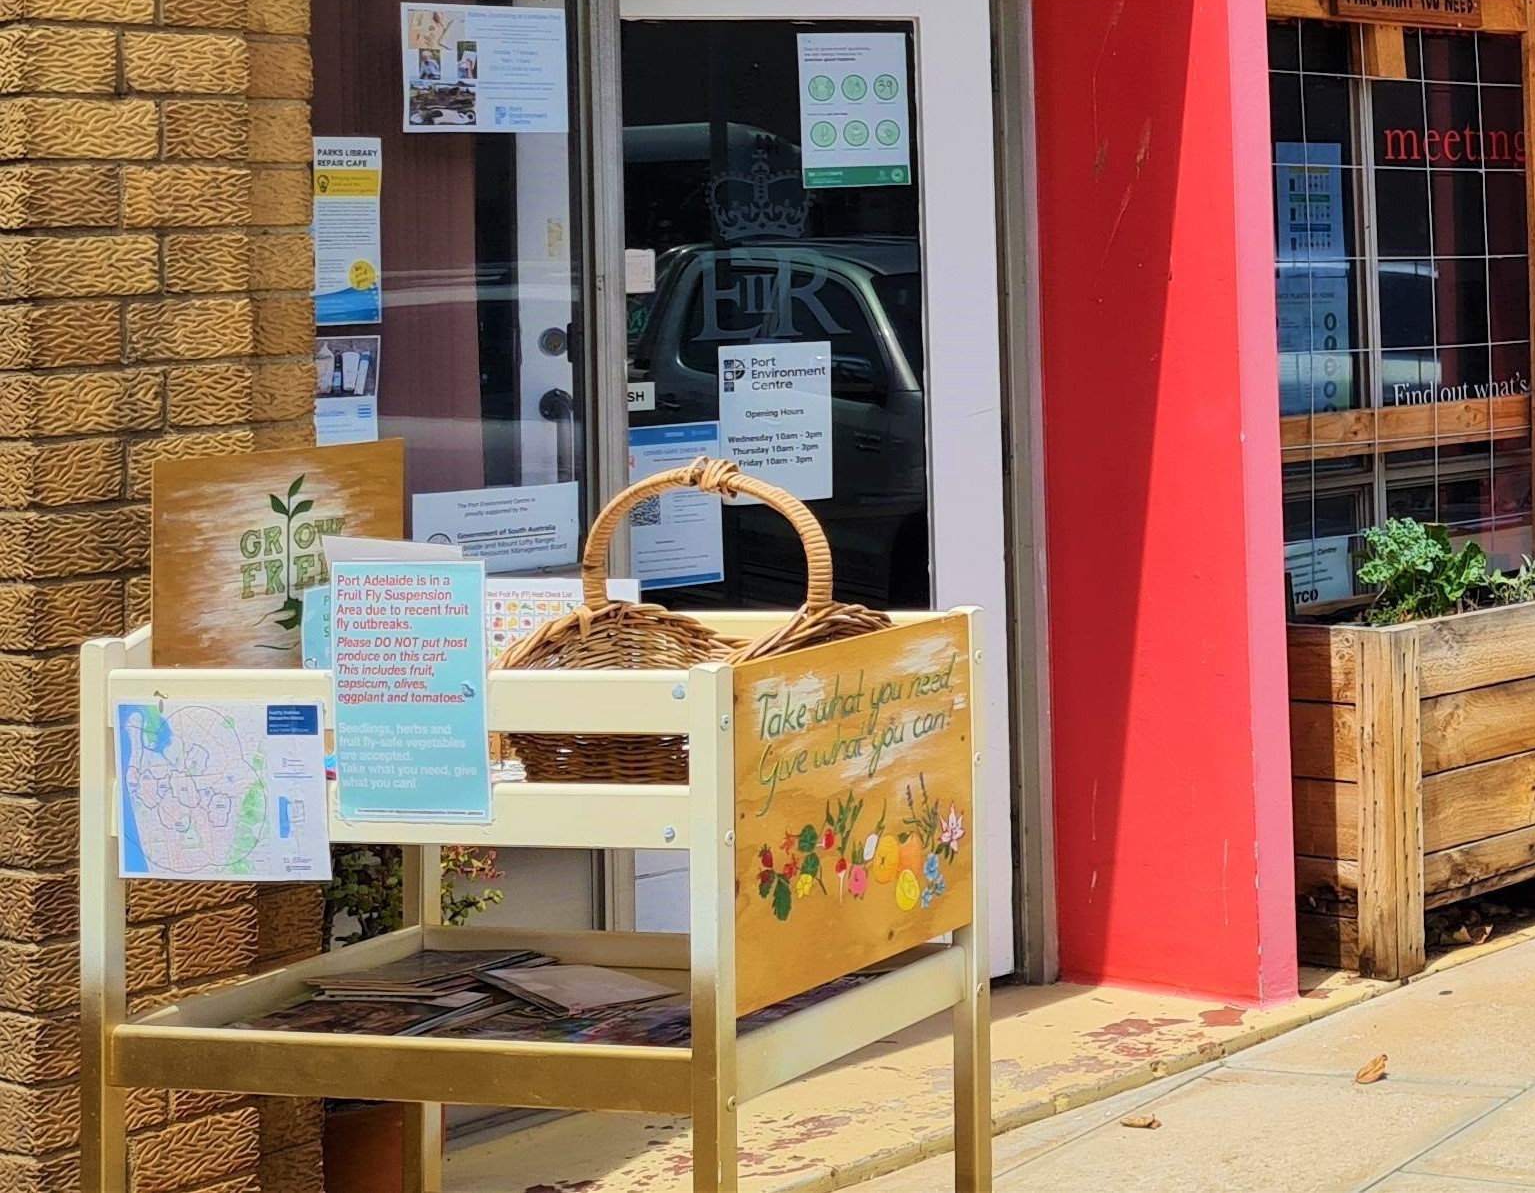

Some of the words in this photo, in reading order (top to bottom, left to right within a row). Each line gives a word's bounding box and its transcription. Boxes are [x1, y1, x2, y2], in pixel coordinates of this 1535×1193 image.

[345, 149, 378, 157] LIBRARY
[752, 358, 776, 367] Port
[752, 366, 826, 379] Environment
[752, 380, 793, 390] Centre
[1393, 381, 1434, 407] Find
[1440, 383, 1469, 401] out
[1474, 371, 1530, 398] what's
[746, 409, 778, 418] Opening
[781, 408, 804, 416] Hours
[728, 434, 773, 444] Wednesday
[805, 431, 822, 440] 3pm
[732, 446, 769, 456] Thursday
[771, 445, 794, 453] 10am
[801, 444, 819, 453] 3pm
[739, 457, 763, 467] Friday
[766, 457, 787, 465] 10am
[795, 456, 813, 464] 3pm
[240, 518, 346, 558] GROW
[457, 529, 498, 540] Government
[499, 528, 506, 536] of
[508, 526, 527, 535] South
[528, 524, 556, 533] Australia
[498, 539, 517, 548] Mount
[519, 537, 534, 547] Lofty
[534, 536, 555, 546] Ranges
[480, 548, 509, 557] Resources
[511, 545, 550, 555] Management
[550, 542, 567, 551] Board
[337, 575, 360, 586] Port
[363, 574, 413, 586] Adelaide
[417, 575, 426, 586] is
[430, 575, 440, 586] in
[443, 577, 450, 586] a
[337, 590, 362, 600] Fruit
[365, 589, 381, 603] Fly
[384, 589, 452, 603] Suspension
[512, 591, 520, 600] Fly
[336, 604, 363, 615] Area
[365, 604, 387, 615] due
[390, 605, 401, 615] to
[404, 605, 442, 615] recent
[445, 604, 469, 615] fruit
[336, 619, 348, 631] fly
[353, 619, 413, 630] outbreaks.
[336, 636, 371, 648] Please
[374, 637, 391, 648] DO
[394, 637, 420, 648] NOT
[422, 638, 440, 650] put
[443, 637, 468, 648] host
[337, 651, 380, 664] produce
[383, 653, 396, 661] on
[400, 651, 419, 661] this
[423, 652, 447, 662] cart.
[338, 665, 359, 675] This
[362, 664, 407, 675] includes
[409, 664, 435, 677] fruit,
[338, 679, 391, 690] capsicum,
[394, 678, 427, 690] olives,
[338, 692, 384, 704] eggplant
[387, 692, 407, 702] and
[411, 692, 466, 703] tomatoes.
[758, 691, 807, 740] Take
[815, 669, 864, 722] what
[869, 682, 902, 735] you
[338, 722, 393, 736] Seedlings,
[397, 723, 428, 734] herbs
[431, 724, 451, 734] and
[340, 737, 360, 747] fruit
[363, 736, 403, 749] fly-safe
[407, 738, 466, 750] vegetables
[340, 752, 357, 761] are
[360, 750, 413, 762] accepted.
[342, 764, 366, 774] Take
[369, 764, 395, 774] what
[399, 766, 417, 777] you
[454, 765, 477, 778] give
[756, 743, 808, 817] Give
[813, 723, 866, 768] what
[868, 724, 905, 778] you
[342, 778, 371, 788] what
[371, 779, 390, 790] you
[393, 777, 416, 788] can!
